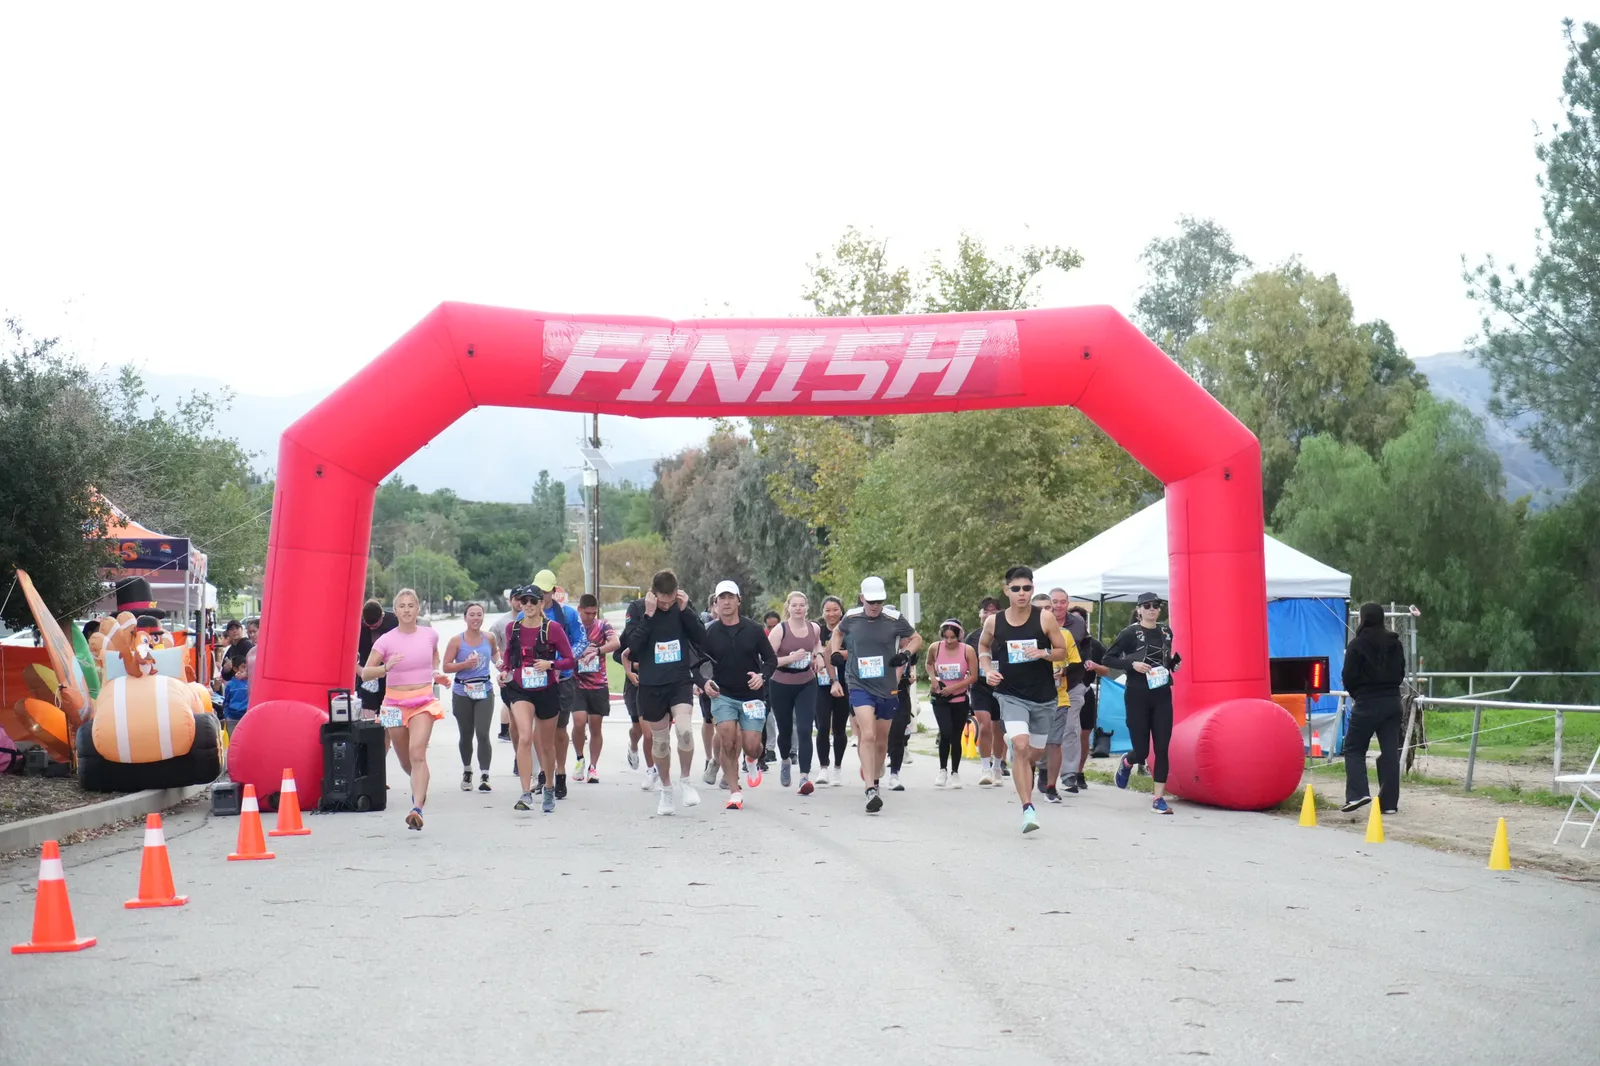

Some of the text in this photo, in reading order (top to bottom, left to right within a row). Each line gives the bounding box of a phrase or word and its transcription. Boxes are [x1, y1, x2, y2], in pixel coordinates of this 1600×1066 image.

[546, 329, 988, 403] FINISH
[659, 652, 678, 662] 2431
[524, 677, 546, 688] 2442
